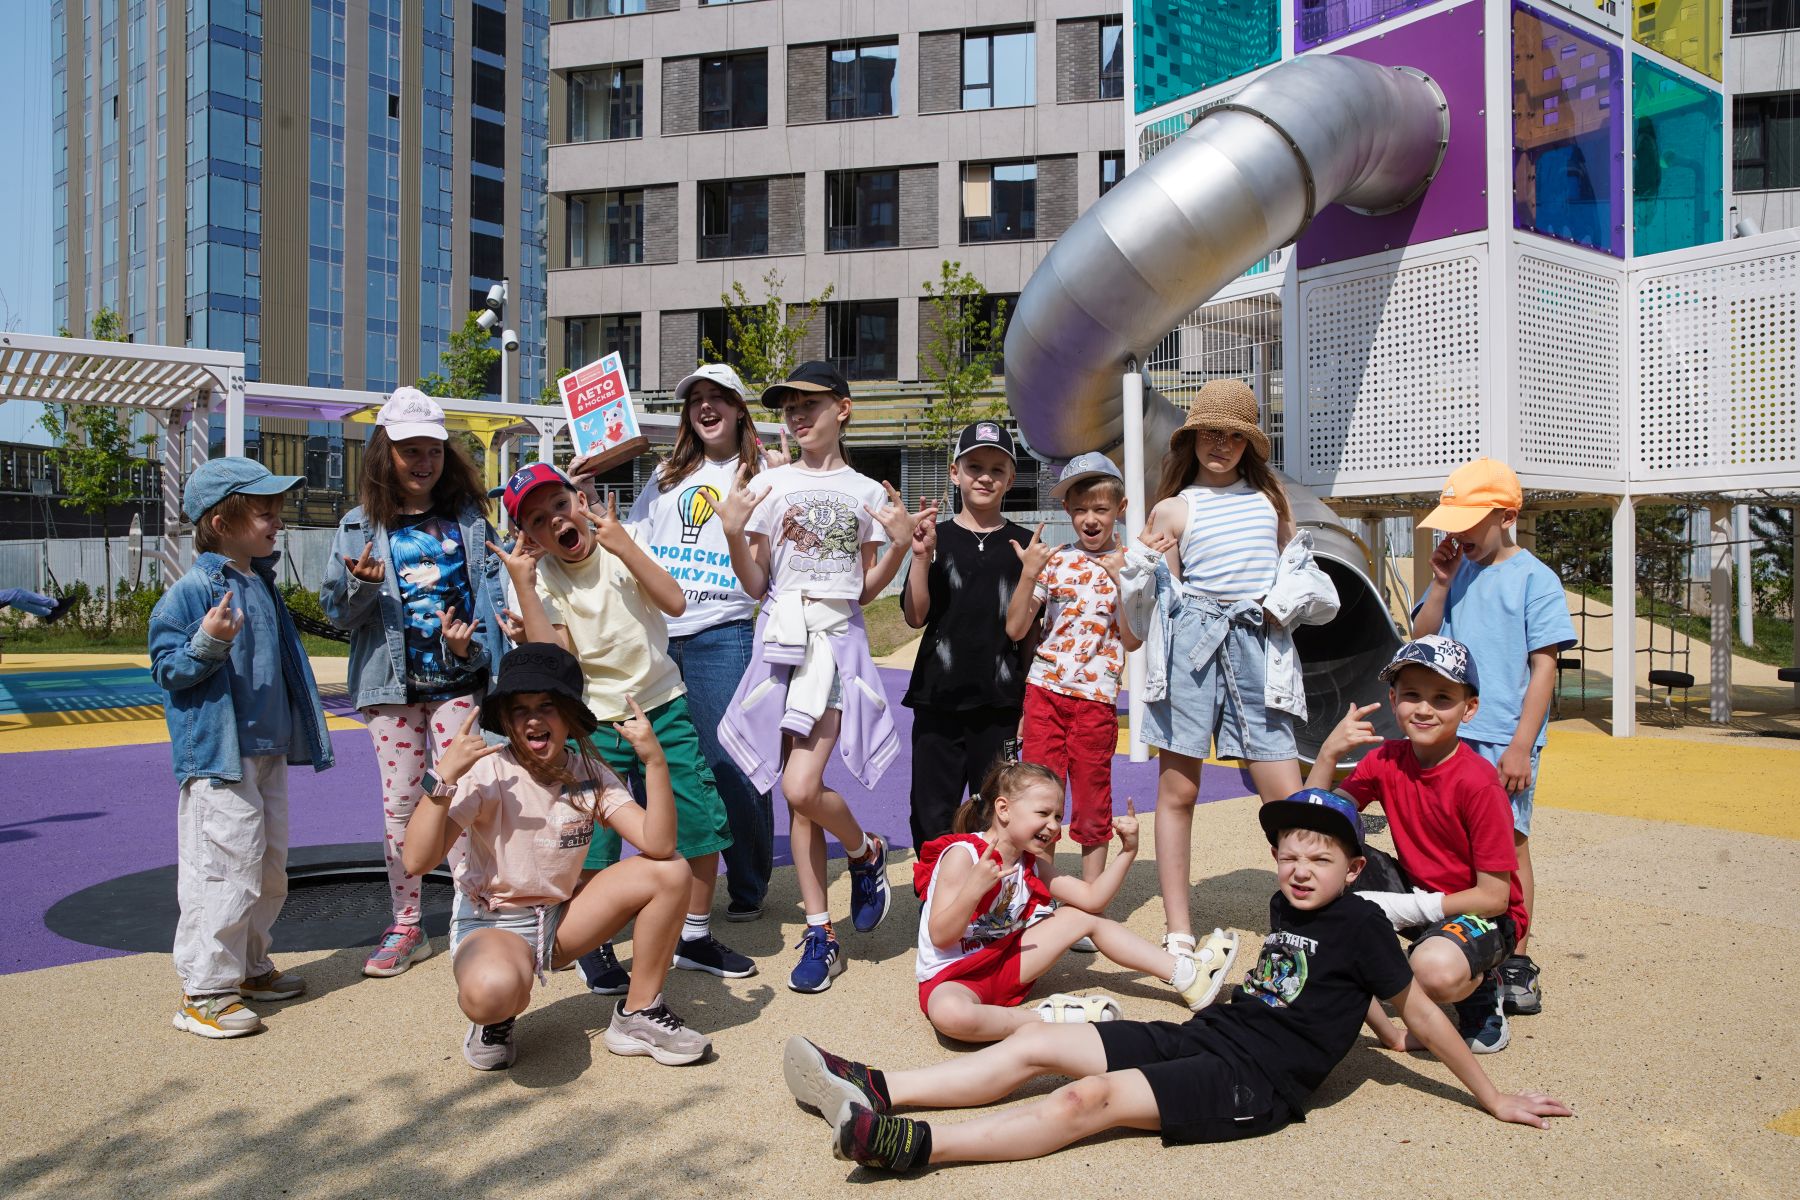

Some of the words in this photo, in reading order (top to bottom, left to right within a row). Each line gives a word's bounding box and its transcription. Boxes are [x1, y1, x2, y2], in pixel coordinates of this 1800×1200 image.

[577, 379, 614, 405] ЛЕТО
[585, 390, 617, 408] МОСКВЕ
[650, 545, 731, 568] РОДСКИ
[665, 566, 737, 590] ИКУЛЫ
